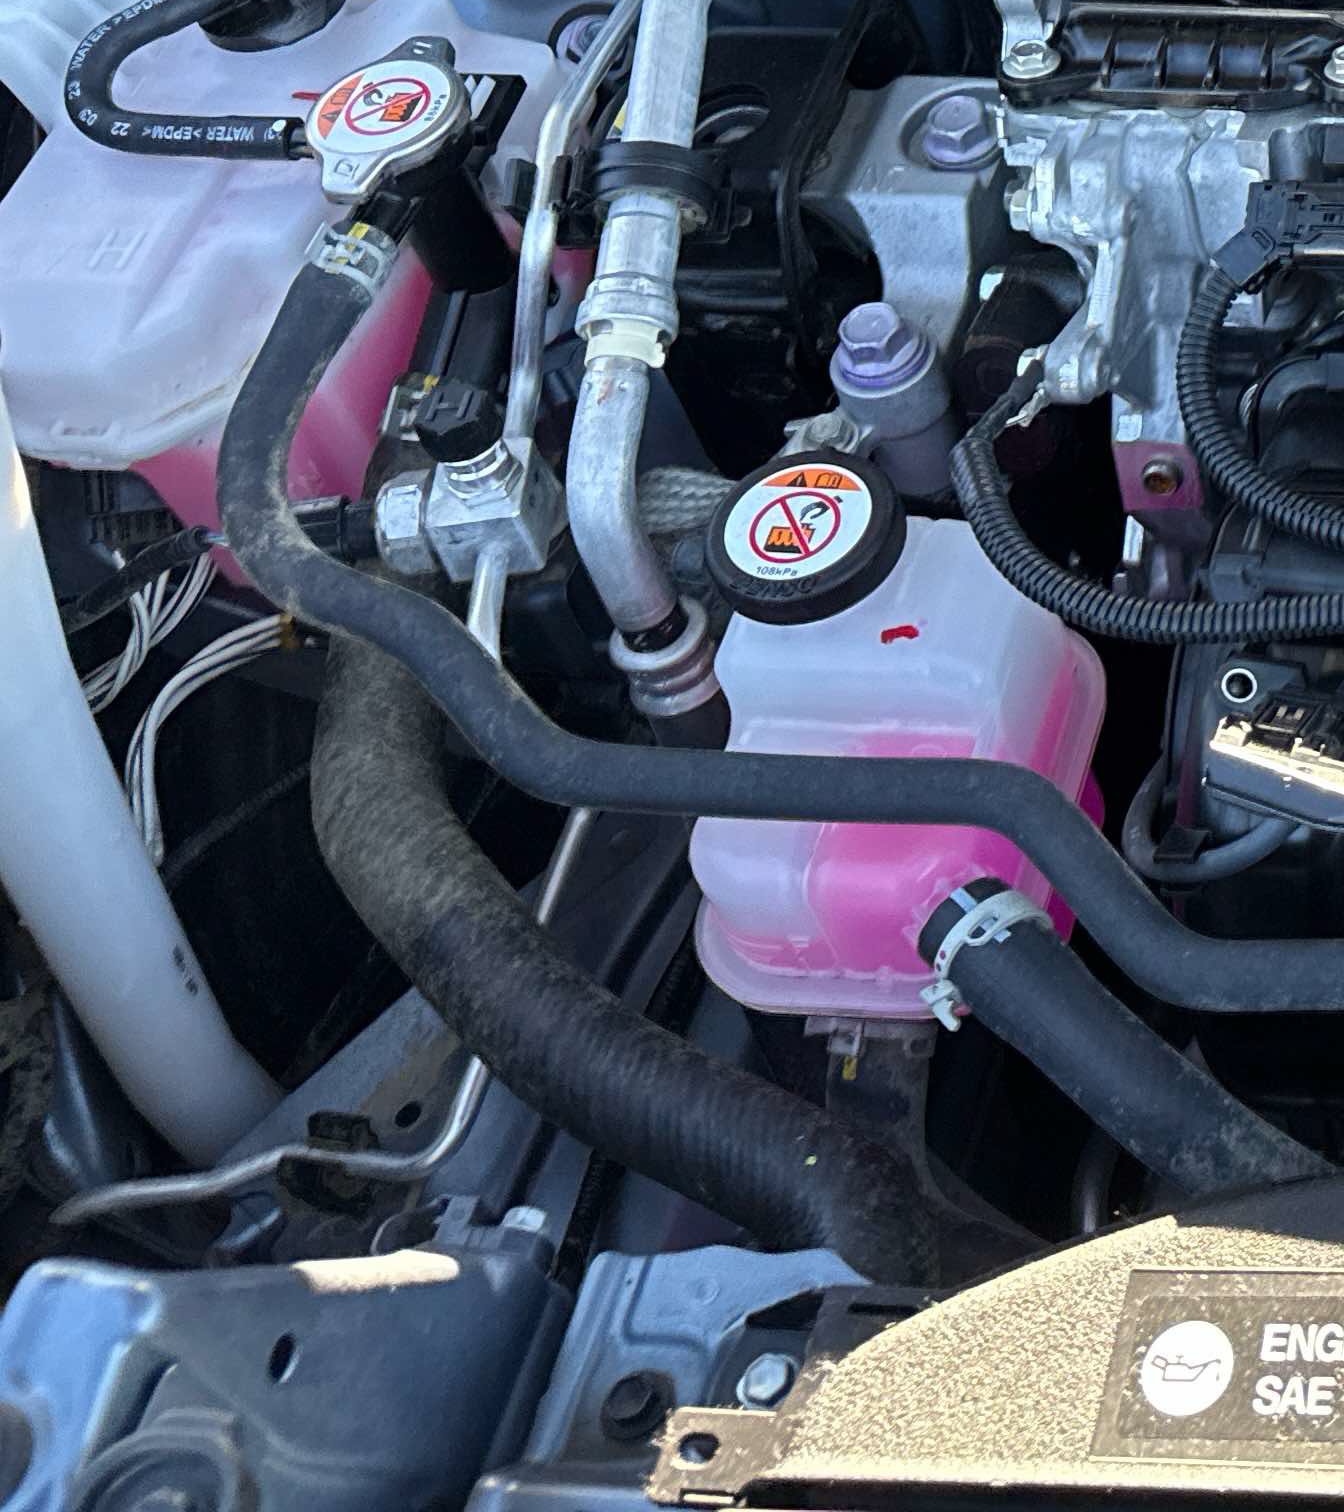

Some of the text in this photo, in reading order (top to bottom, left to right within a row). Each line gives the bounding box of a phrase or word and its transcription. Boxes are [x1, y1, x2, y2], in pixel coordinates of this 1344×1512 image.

[70, 23, 112, 71] WATER
[110, 121, 131, 136] 22
[206, 124, 254, 141] WATER
[424, 390, 474, 422] H
[755, 565, 799, 577] 108kPa
[1252, 1375, 1337, 1417] SAE
